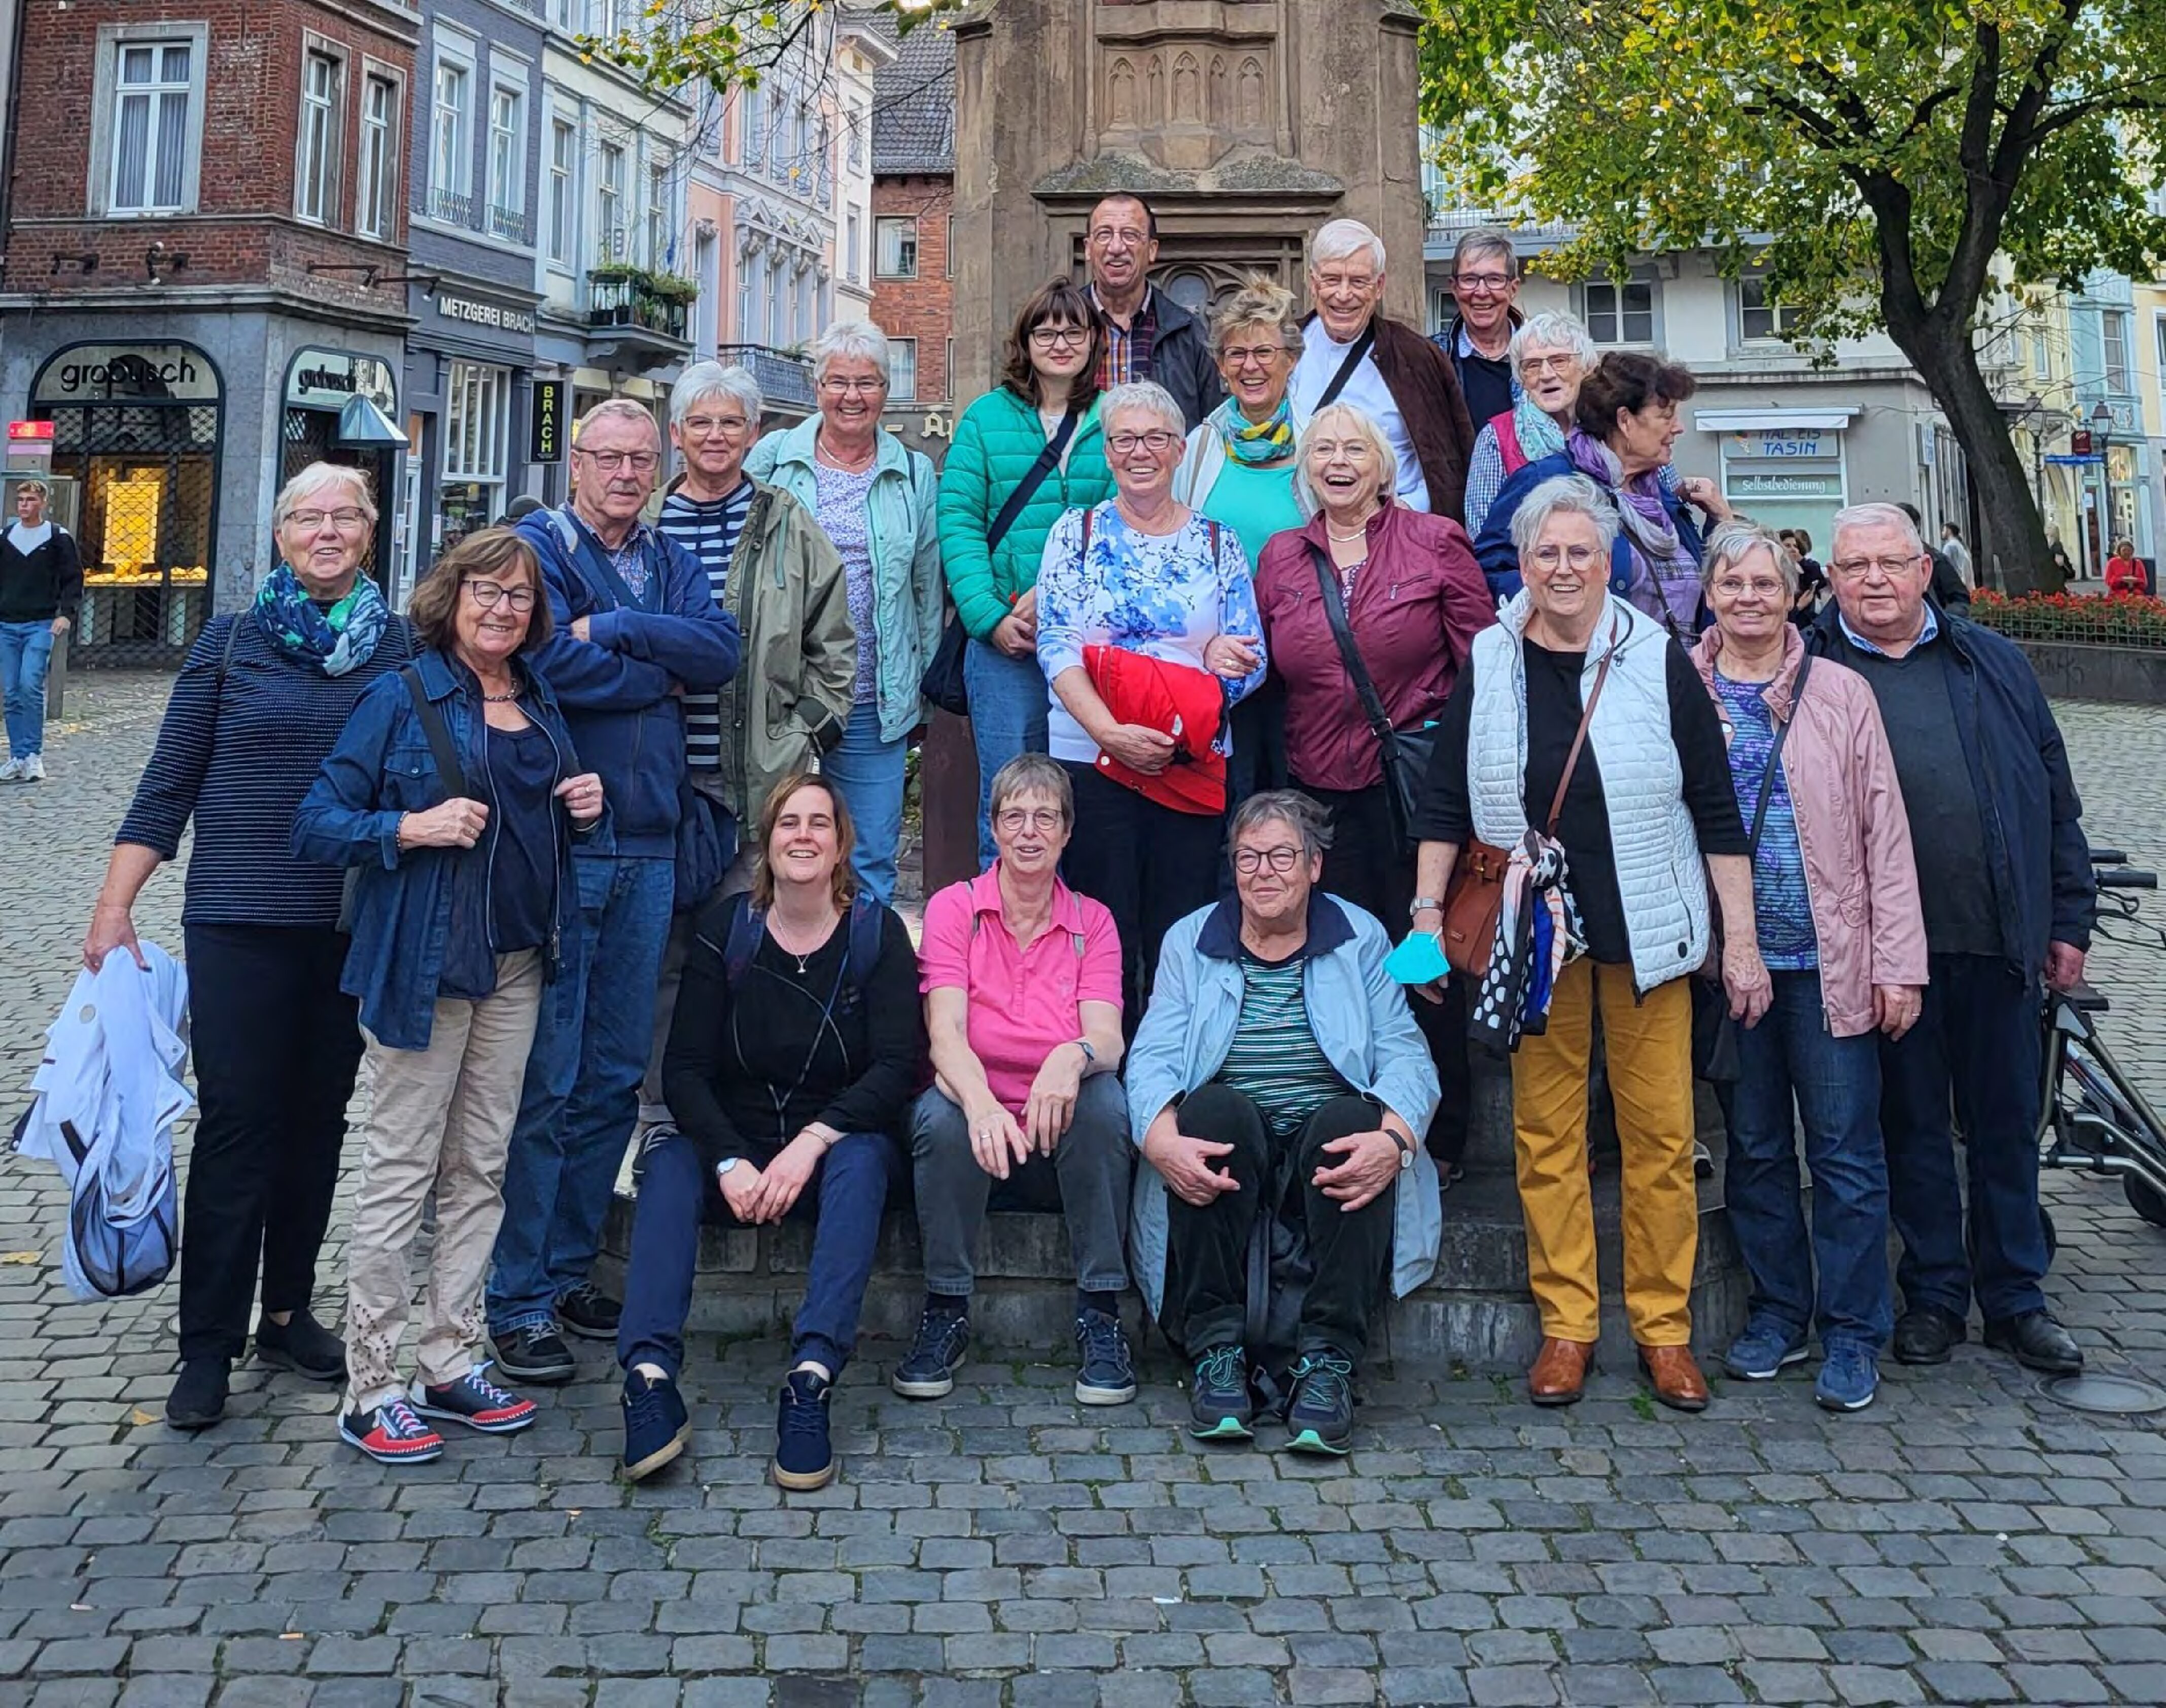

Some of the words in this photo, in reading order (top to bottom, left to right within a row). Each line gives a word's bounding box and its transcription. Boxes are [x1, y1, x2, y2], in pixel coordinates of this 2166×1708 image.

[440, 296, 500, 327] METZGEREI
[502, 310, 535, 333] BRACH
[541, 386, 554, 453] BRACH
[1797, 430, 1822, 440] EIS
[1763, 441, 1817, 455] TASIN
